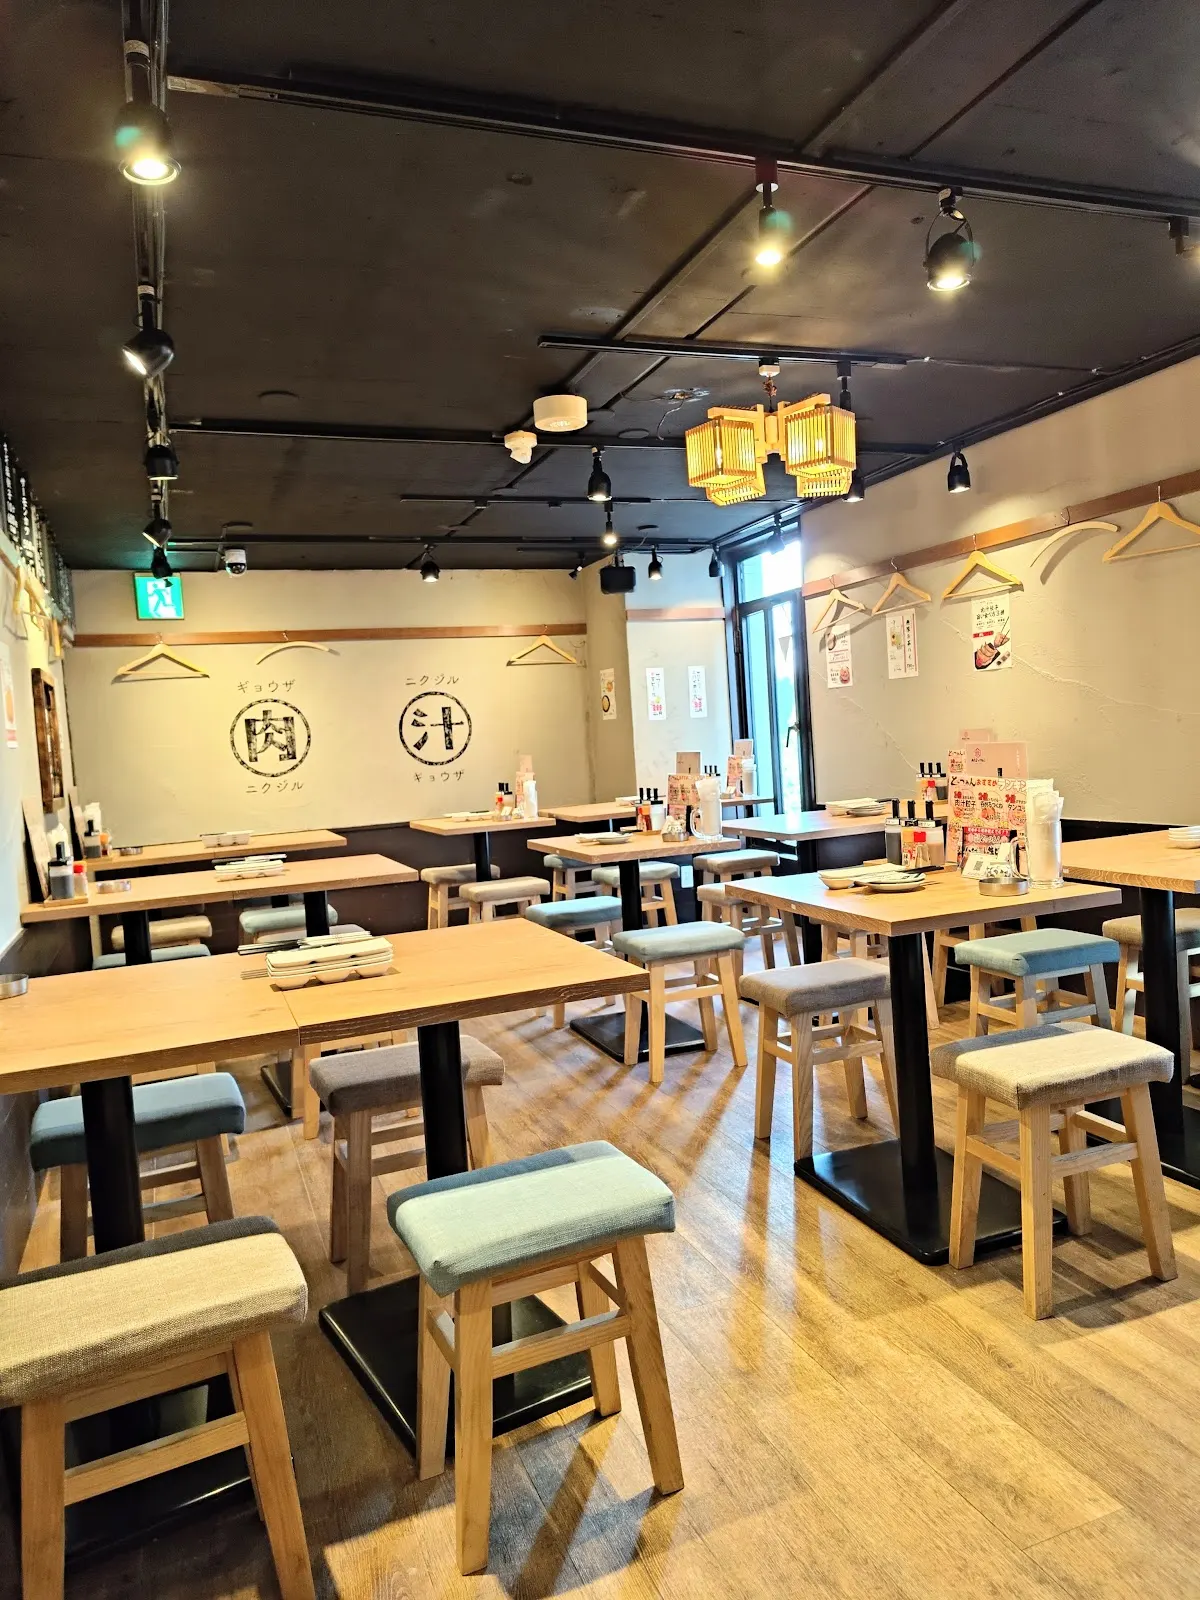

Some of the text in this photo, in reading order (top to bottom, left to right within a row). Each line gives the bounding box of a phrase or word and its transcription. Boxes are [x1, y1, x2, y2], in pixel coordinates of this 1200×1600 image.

[237, 679, 296, 693] ギョウザ
[405, 673, 460, 686] ニクジル
[410, 706, 464, 751] 汁
[244, 710, 297, 763] 肉
[246, 781, 304, 794] ニクジル
